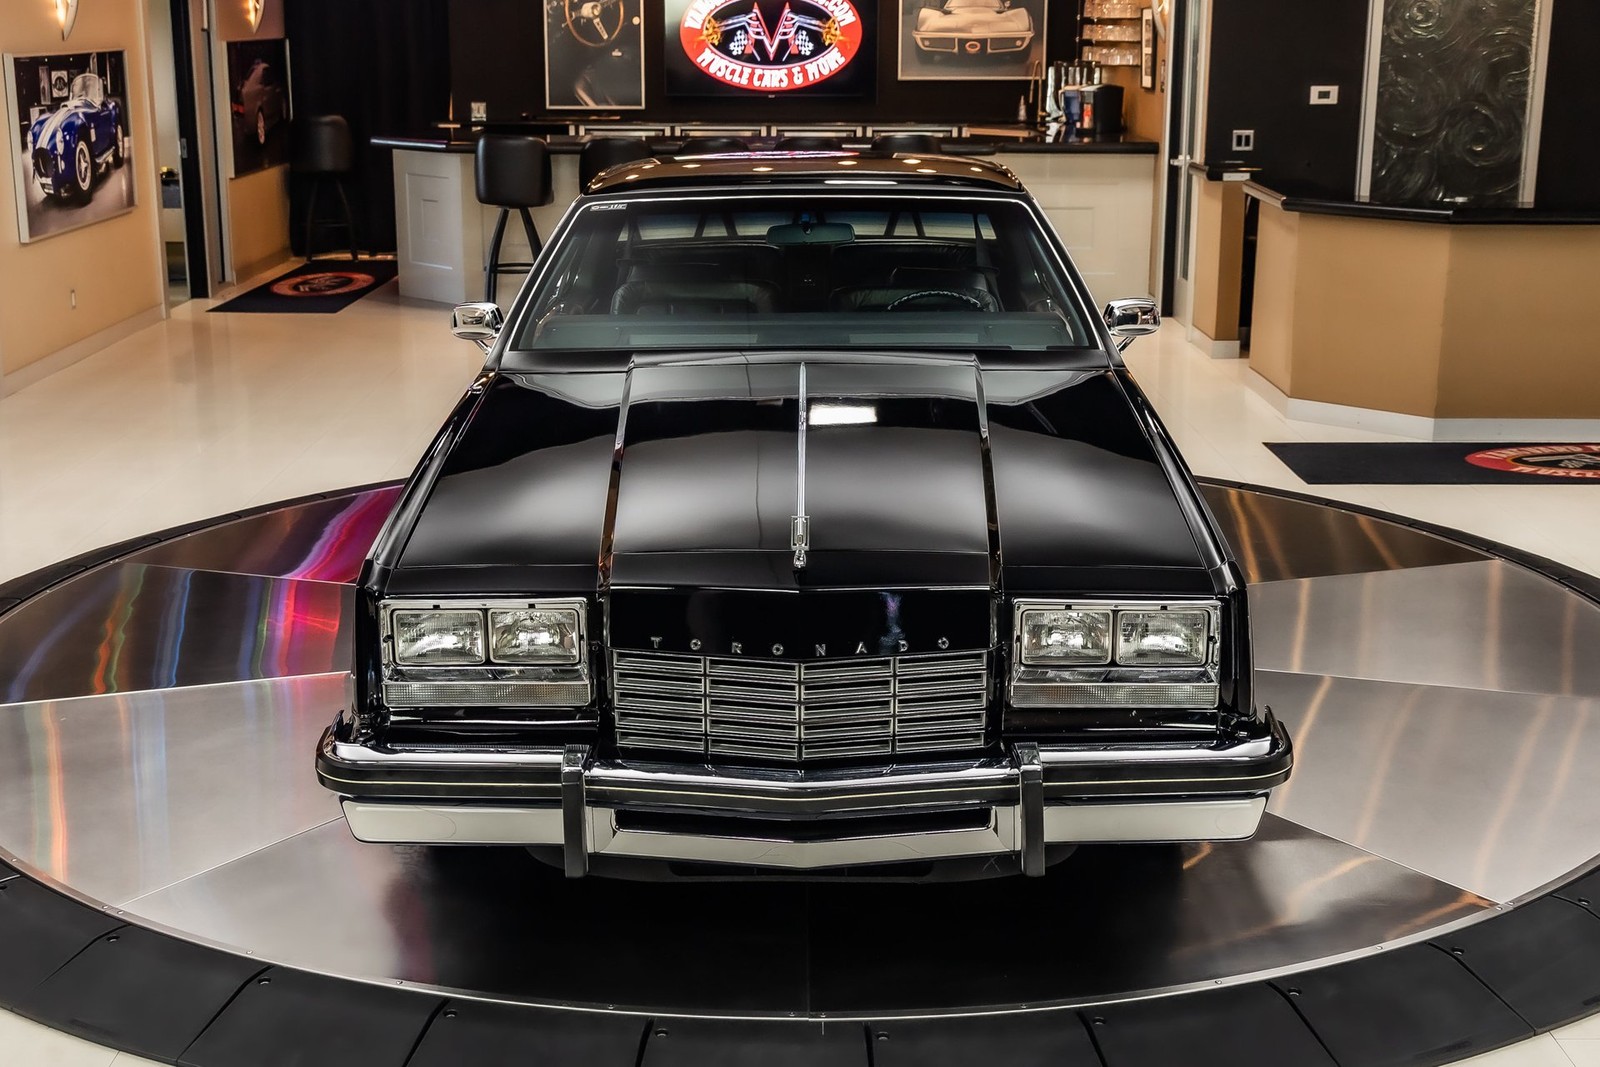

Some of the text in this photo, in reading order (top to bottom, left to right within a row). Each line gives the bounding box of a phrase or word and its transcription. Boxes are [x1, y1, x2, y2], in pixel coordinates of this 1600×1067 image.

[696, 46, 846, 88] MUSCLE CARS & MORE
[651, 636, 949, 656] TORONADO
